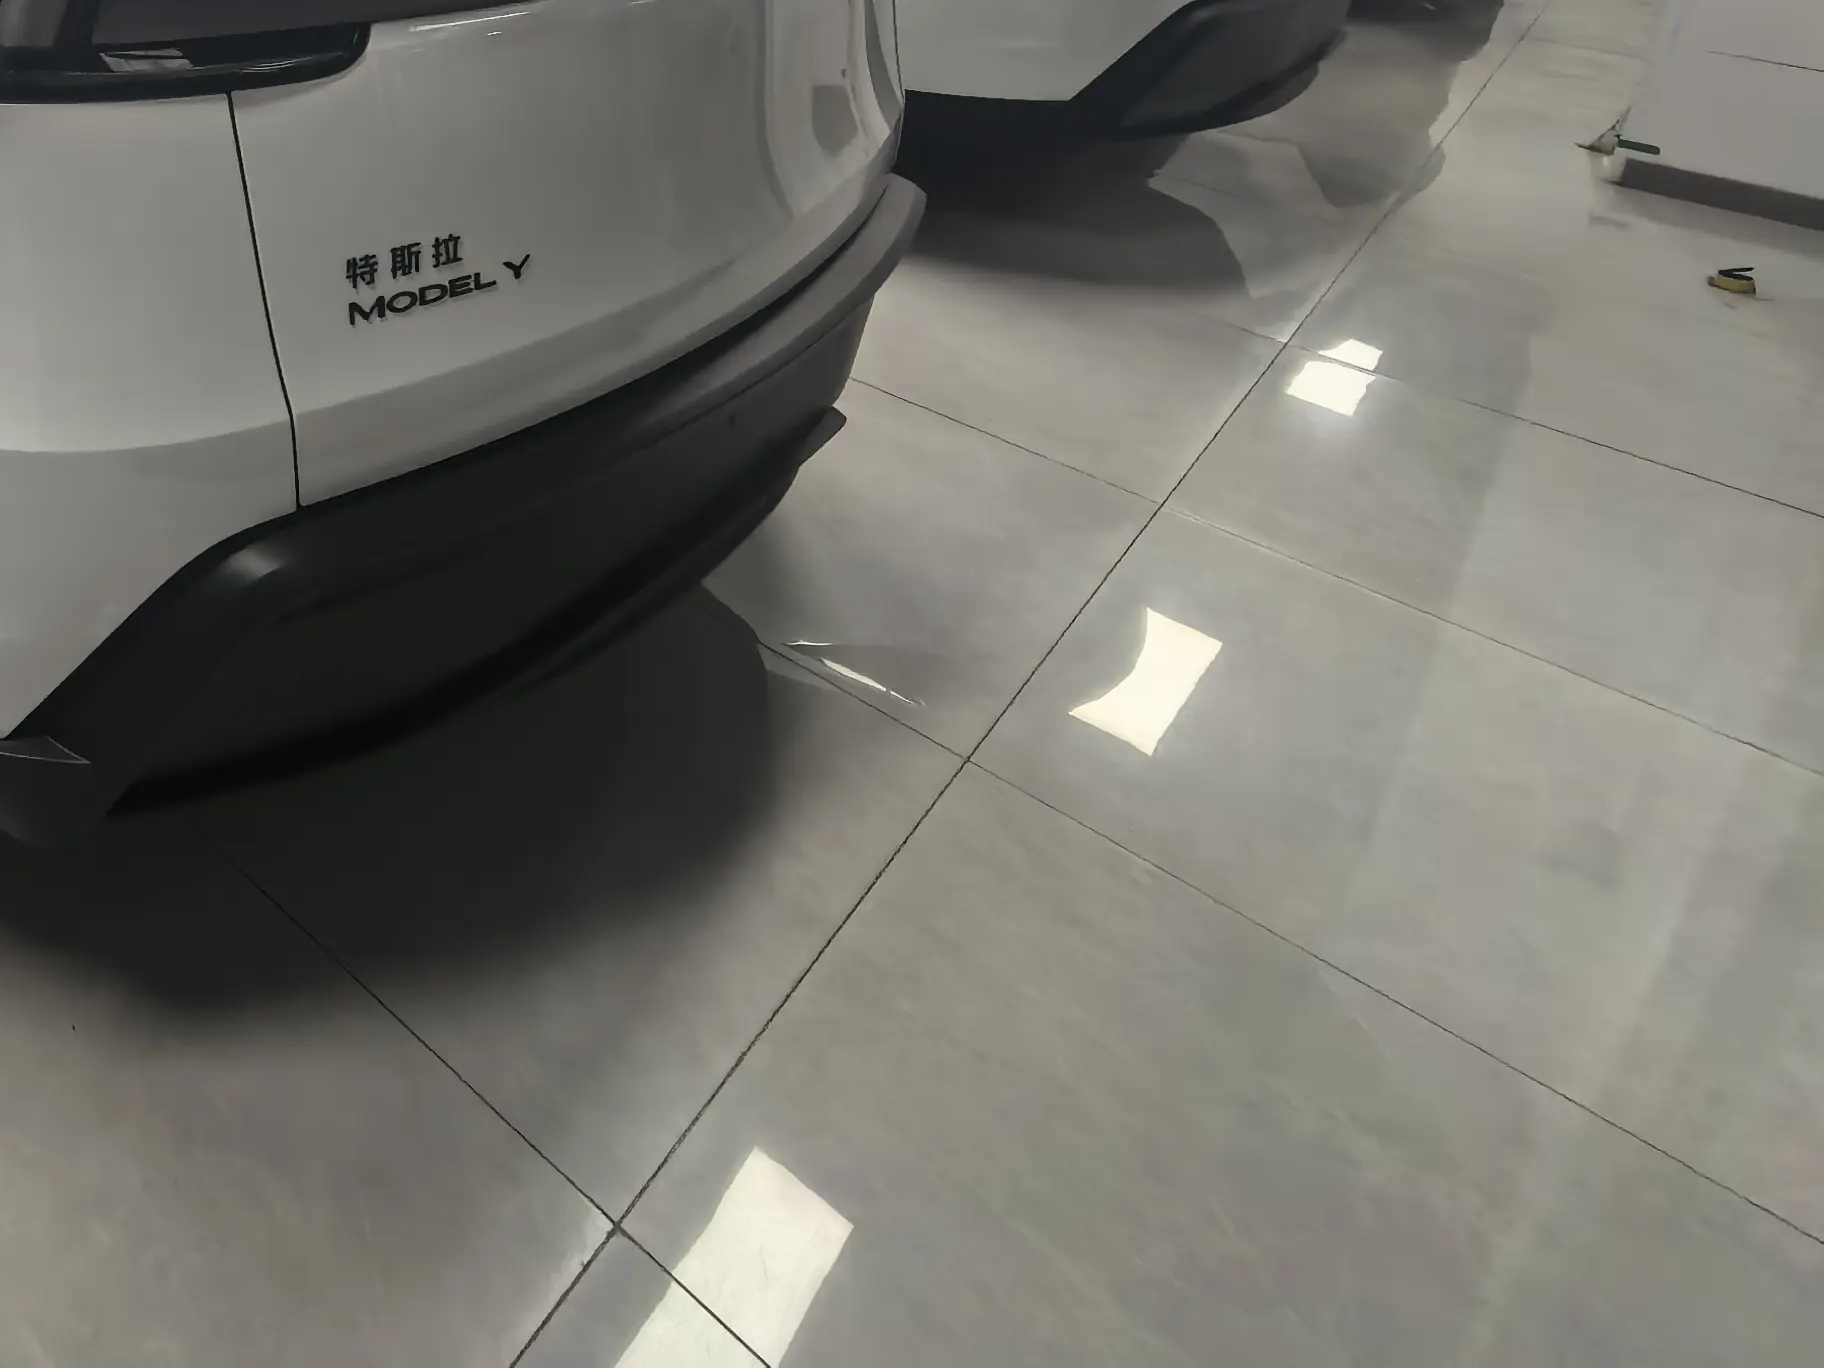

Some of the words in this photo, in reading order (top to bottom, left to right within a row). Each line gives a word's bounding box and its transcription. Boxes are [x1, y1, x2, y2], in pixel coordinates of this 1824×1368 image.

[345, 233, 463, 292] 特斯拉
[348, 272, 497, 327] MODEL
[503, 253, 531, 280] Y
